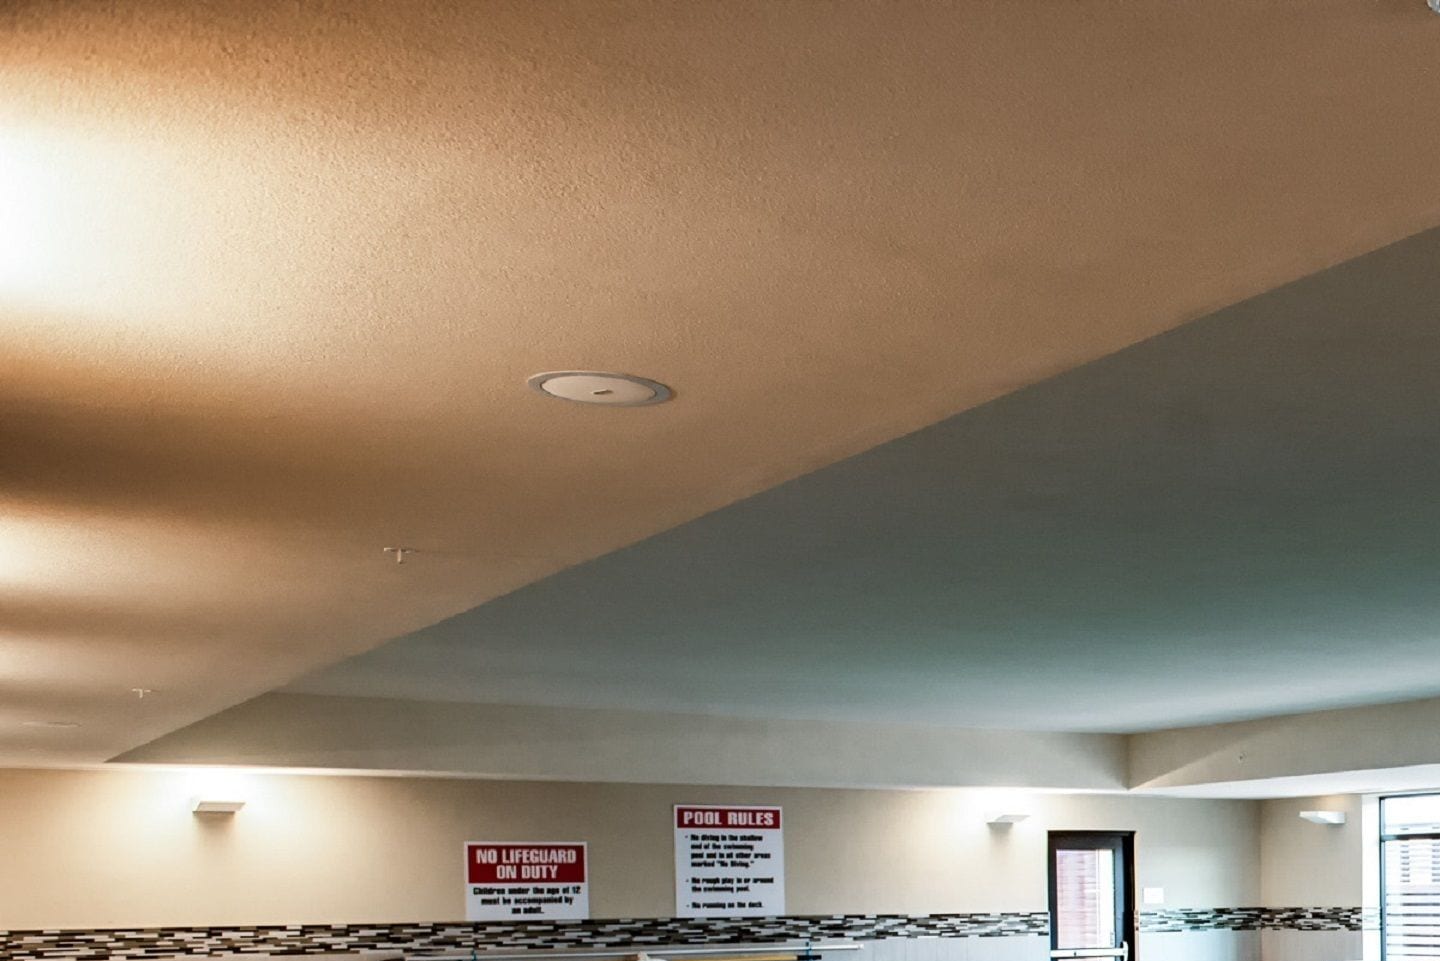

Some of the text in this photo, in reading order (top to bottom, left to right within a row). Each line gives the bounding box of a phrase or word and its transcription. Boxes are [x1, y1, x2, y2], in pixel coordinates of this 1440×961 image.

[683, 811, 773, 825] POOL RULES
[476, 849, 576, 864] NO LIFEGUARD
[497, 865, 558, 879] ON DUTY
[473, 887, 505, 895] Children
[573, 886, 581, 894] 12
[481, 897, 499, 905] must
[515, 896, 562, 905] accompanied
[565, 896, 573, 905] by
